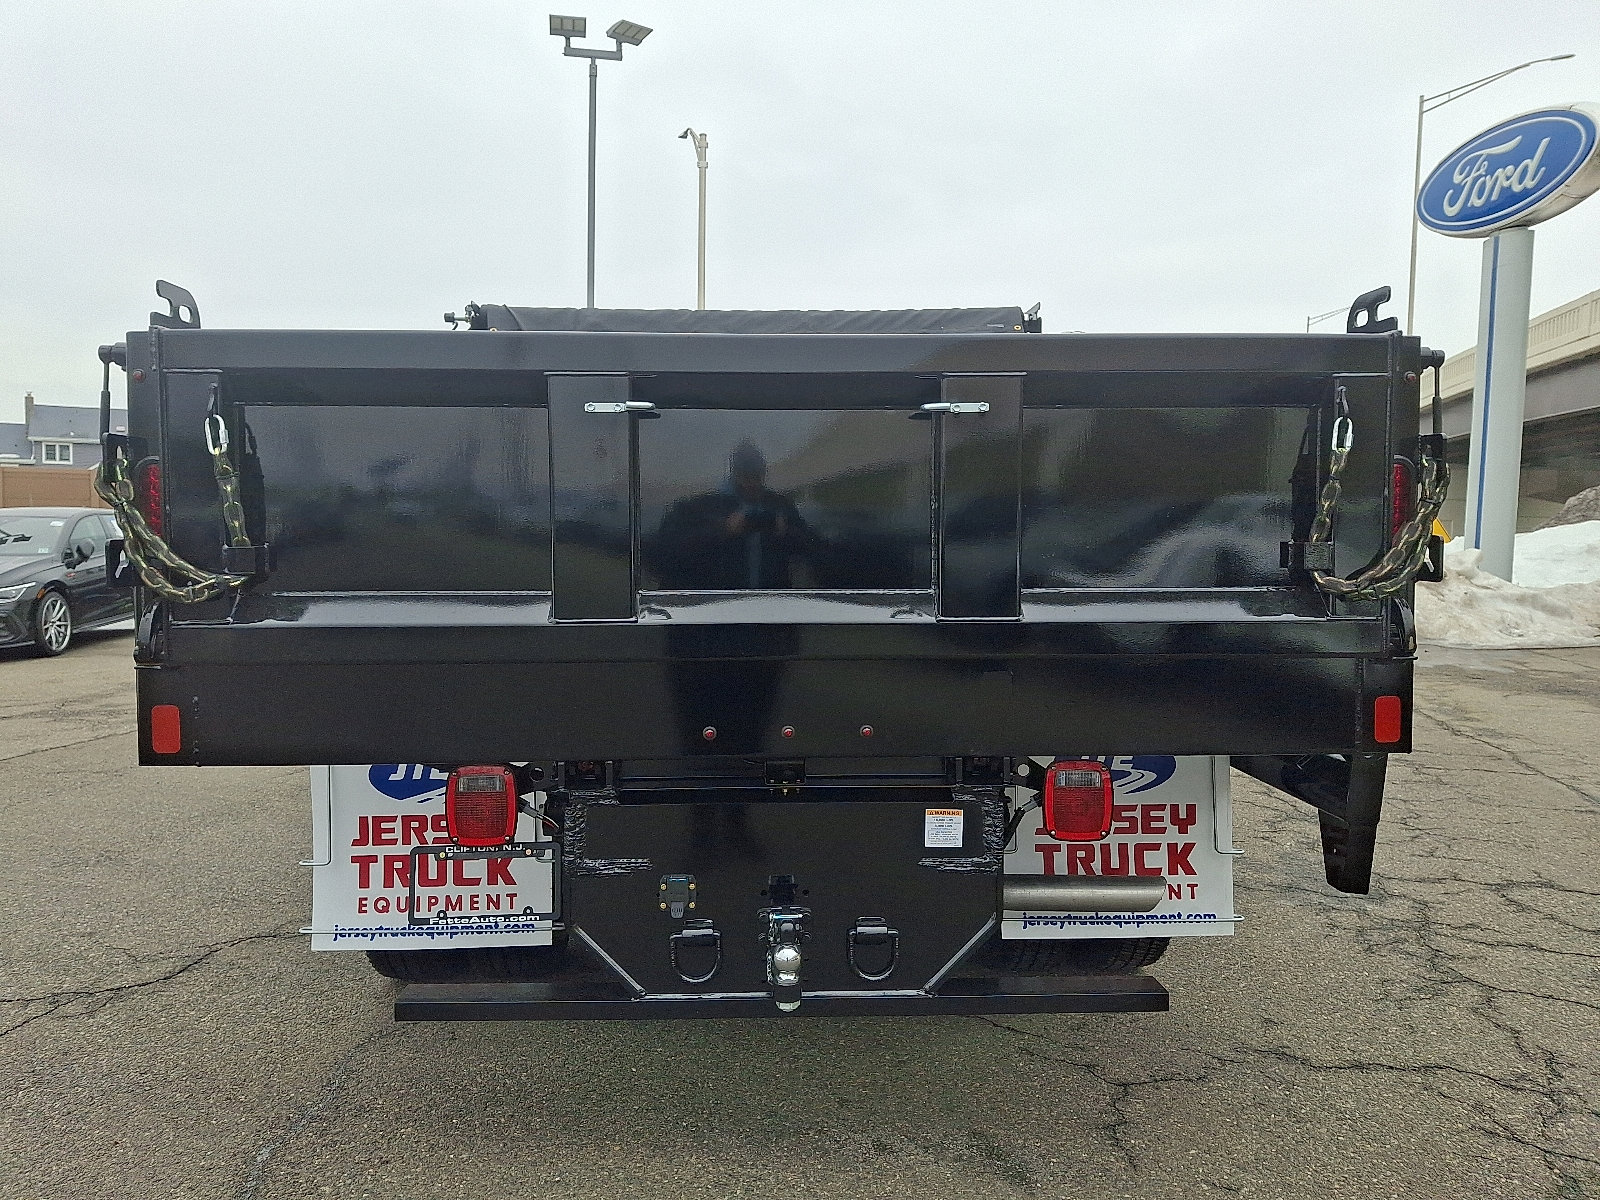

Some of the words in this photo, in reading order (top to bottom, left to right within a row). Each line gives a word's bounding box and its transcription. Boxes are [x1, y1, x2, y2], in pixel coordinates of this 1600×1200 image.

[1443, 135, 1551, 216] Ford
[351, 814, 453, 846] JERS
[351, 855, 517, 889] TRUCK
[1035, 843, 1197, 876] TRUCK
[357, 893, 518, 914] EQUIPMENT
[333, 922, 535, 941] jerseytruckequipment.com
[1022, 912, 1217, 929] jerseytruckequipment.com
